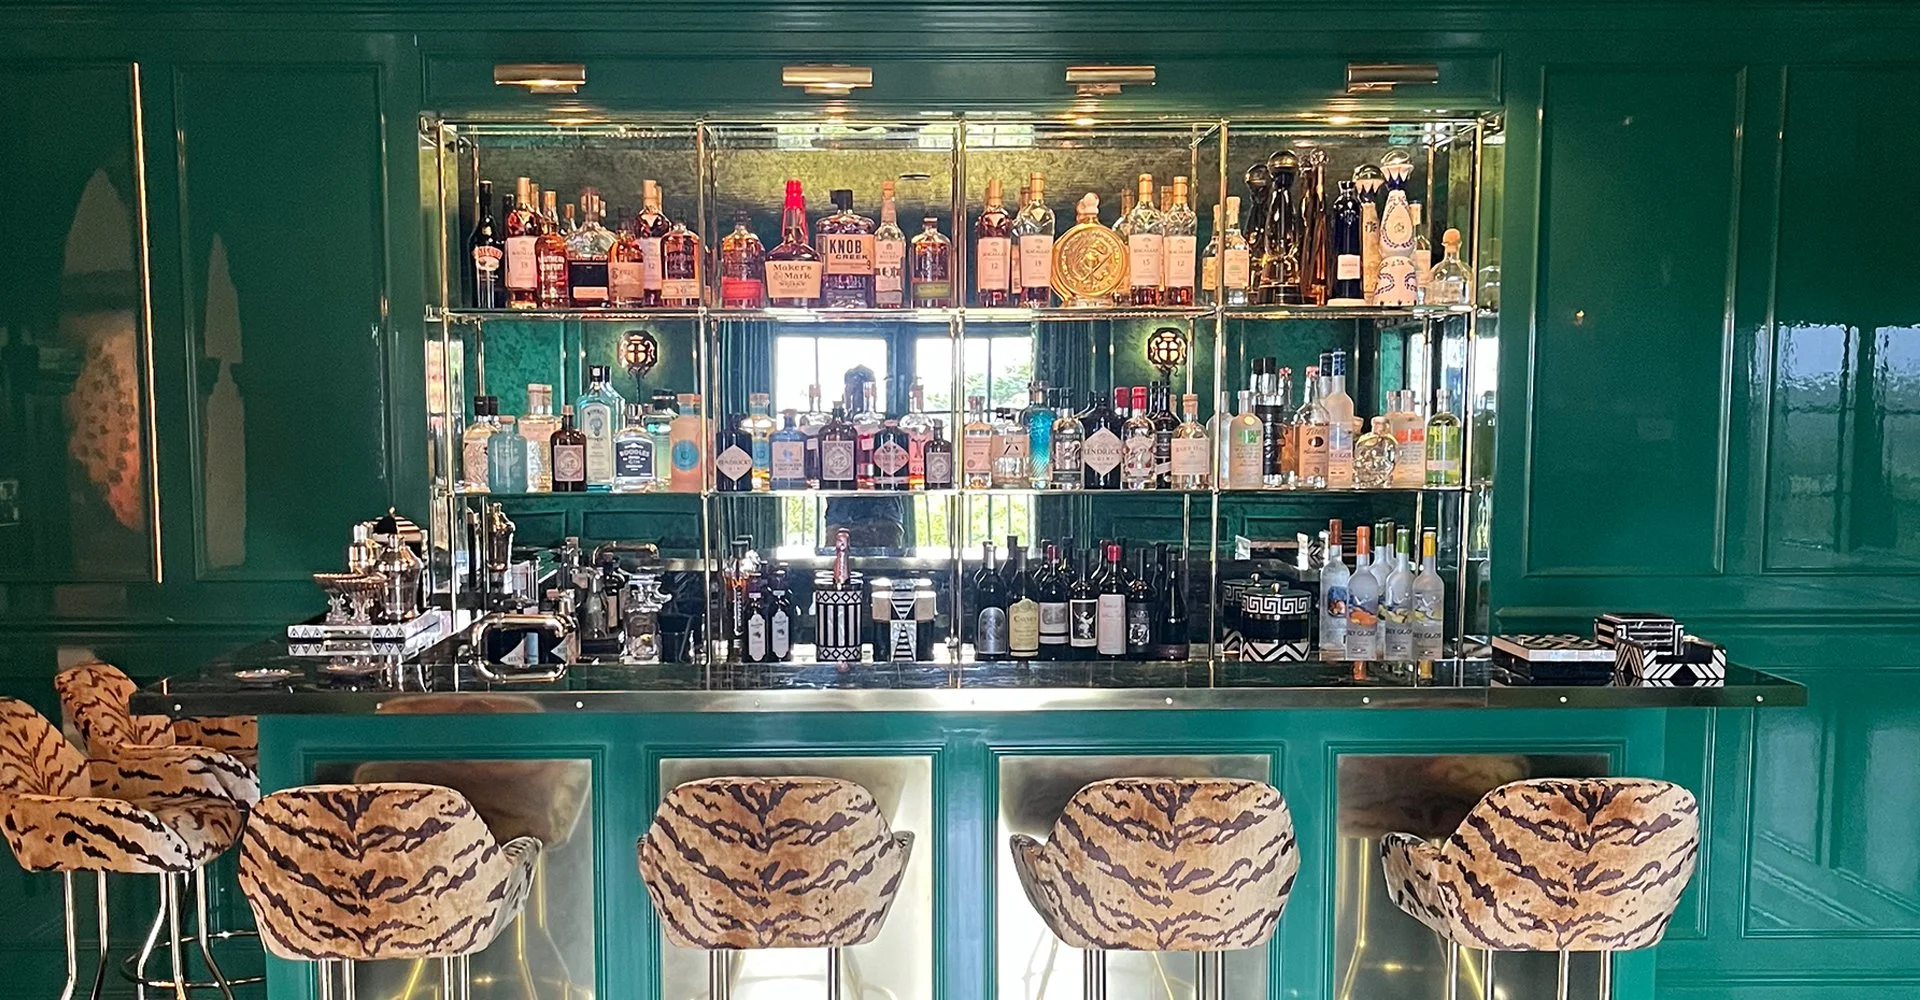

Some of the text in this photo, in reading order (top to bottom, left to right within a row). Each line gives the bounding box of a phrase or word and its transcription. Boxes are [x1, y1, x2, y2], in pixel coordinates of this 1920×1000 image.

[829, 239, 862, 254] KNOB
[784, 271, 812, 280] Mark
[619, 449, 650, 458] BOODLES
